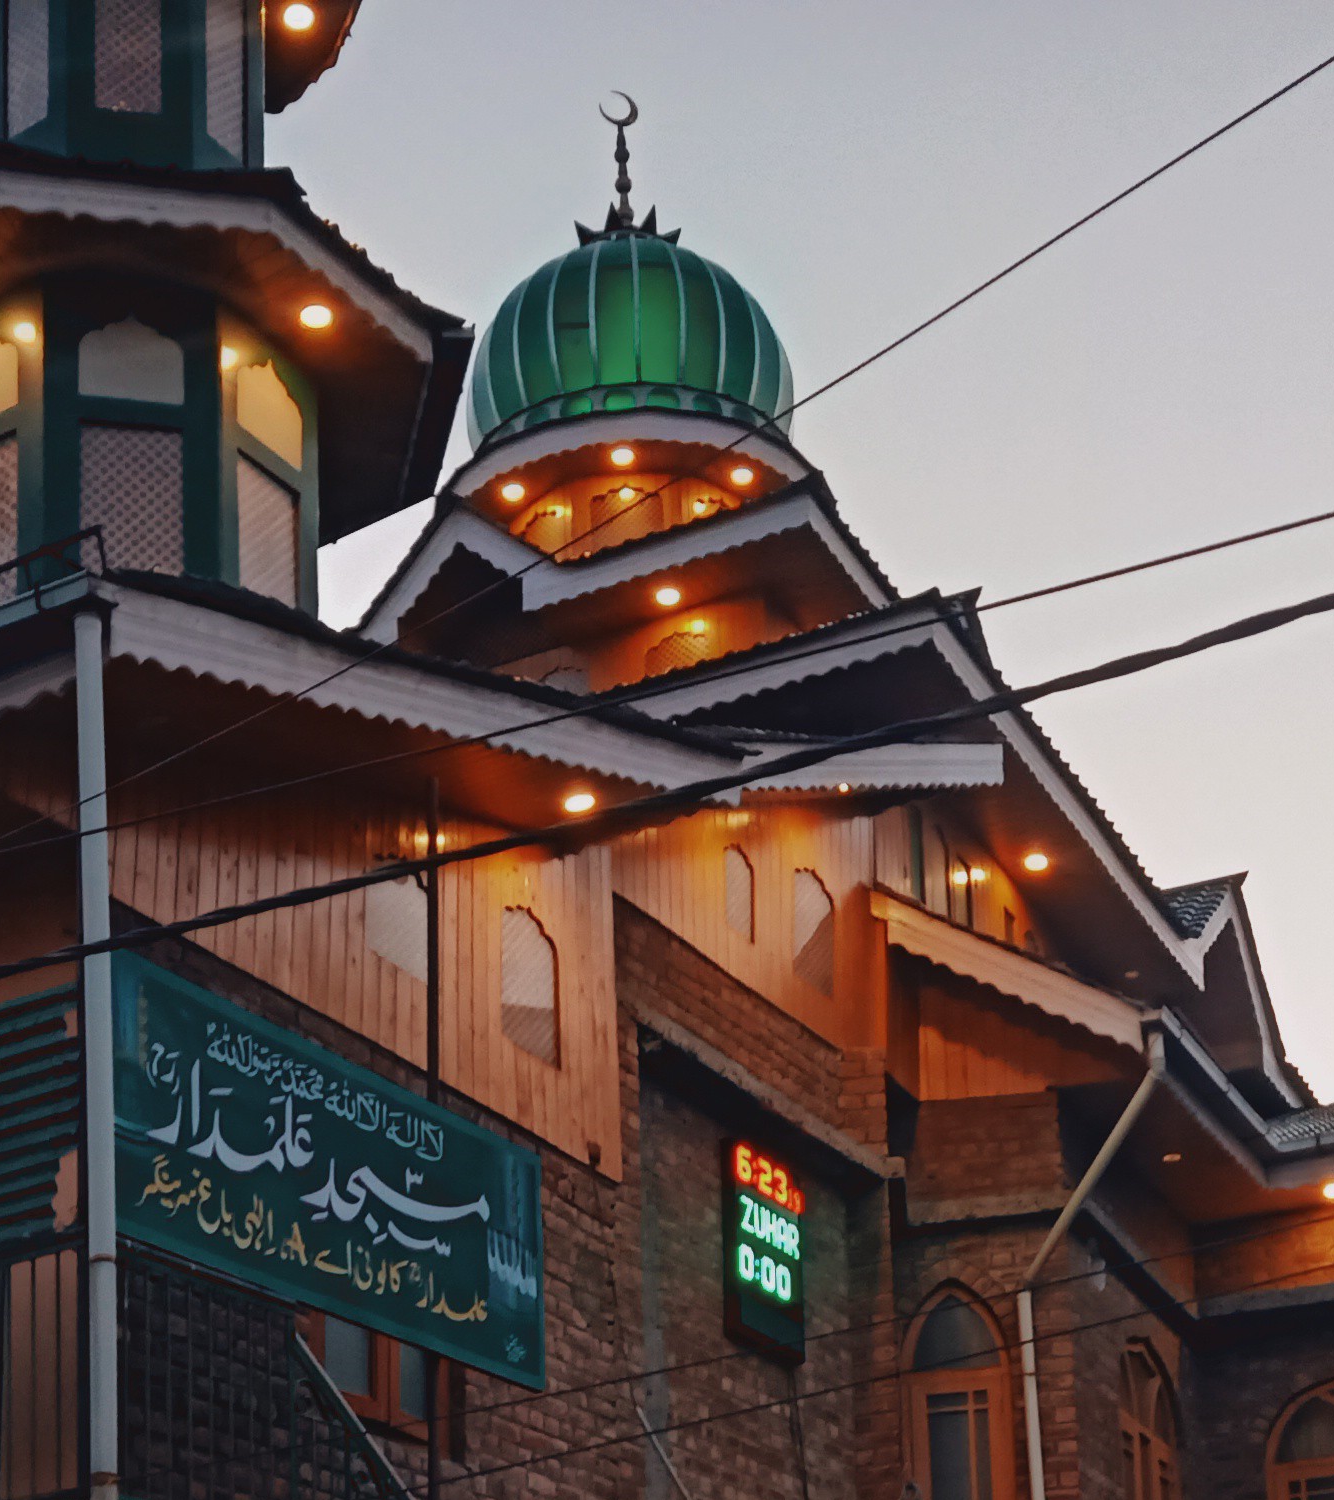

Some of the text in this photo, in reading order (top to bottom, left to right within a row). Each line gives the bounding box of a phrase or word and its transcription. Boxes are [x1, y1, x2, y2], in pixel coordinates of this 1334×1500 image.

[736, 1144, 788, 1205] 6:23
[739, 1194, 801, 1261] ZUHAR
[737, 1243, 792, 1302] 0:00
